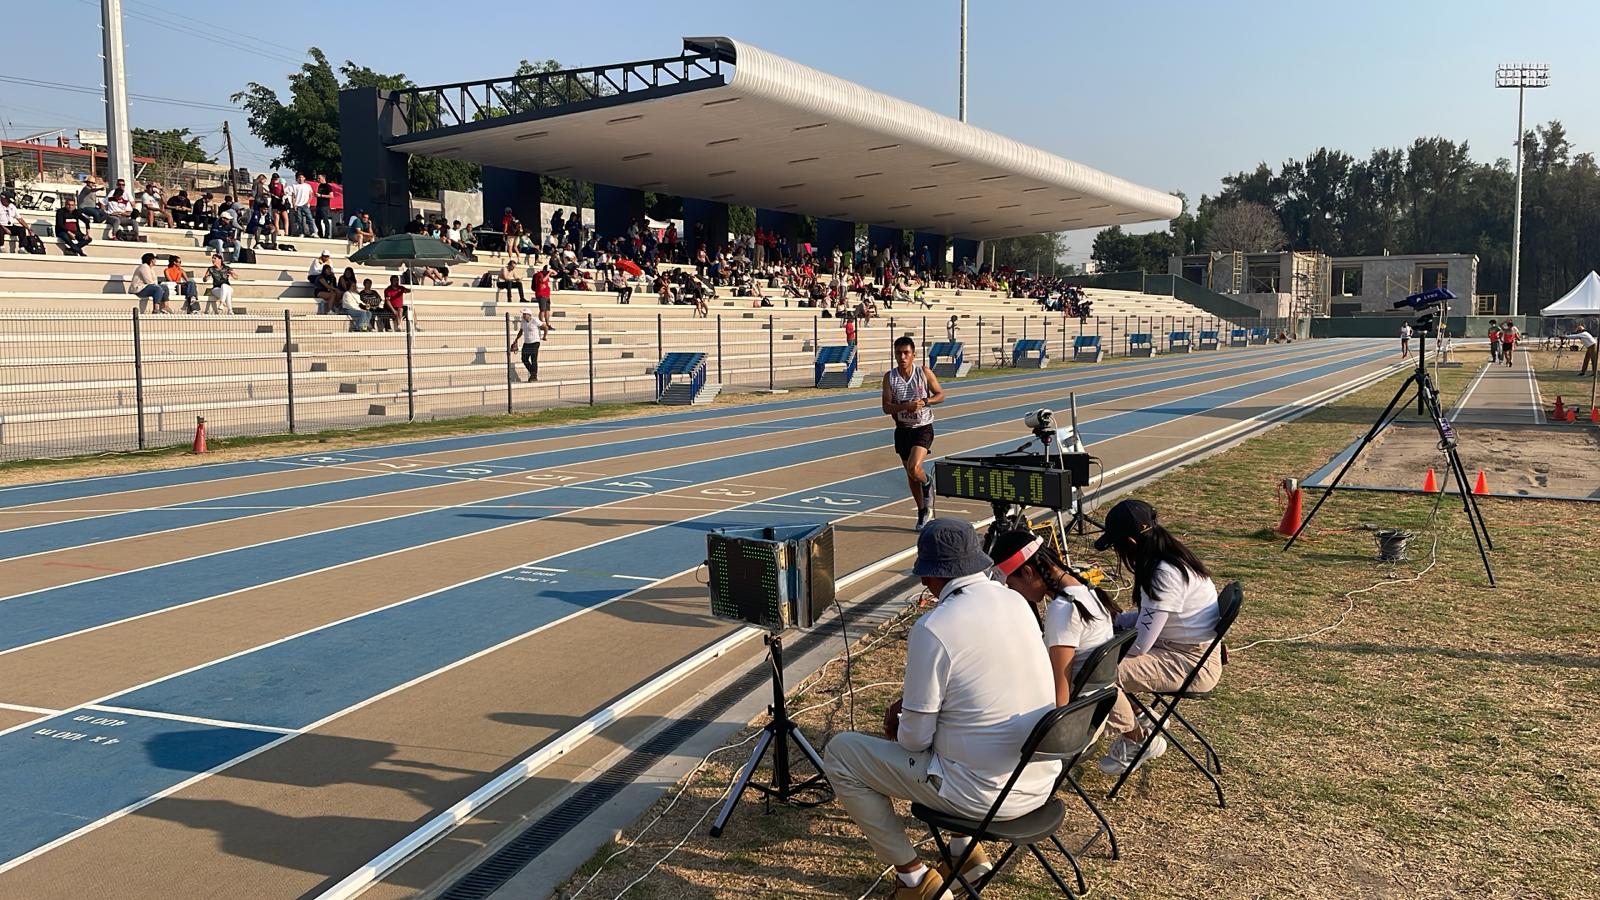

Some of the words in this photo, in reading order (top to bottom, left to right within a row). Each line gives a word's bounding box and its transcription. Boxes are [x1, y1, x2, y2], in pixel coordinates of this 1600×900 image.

[302, 455, 346, 464] 8
[446, 467, 493, 475] 6
[526, 474, 578, 482] 5
[604, 481, 654, 489] 4
[699, 487, 756, 497] 3
[800, 496, 862, 506] 2
